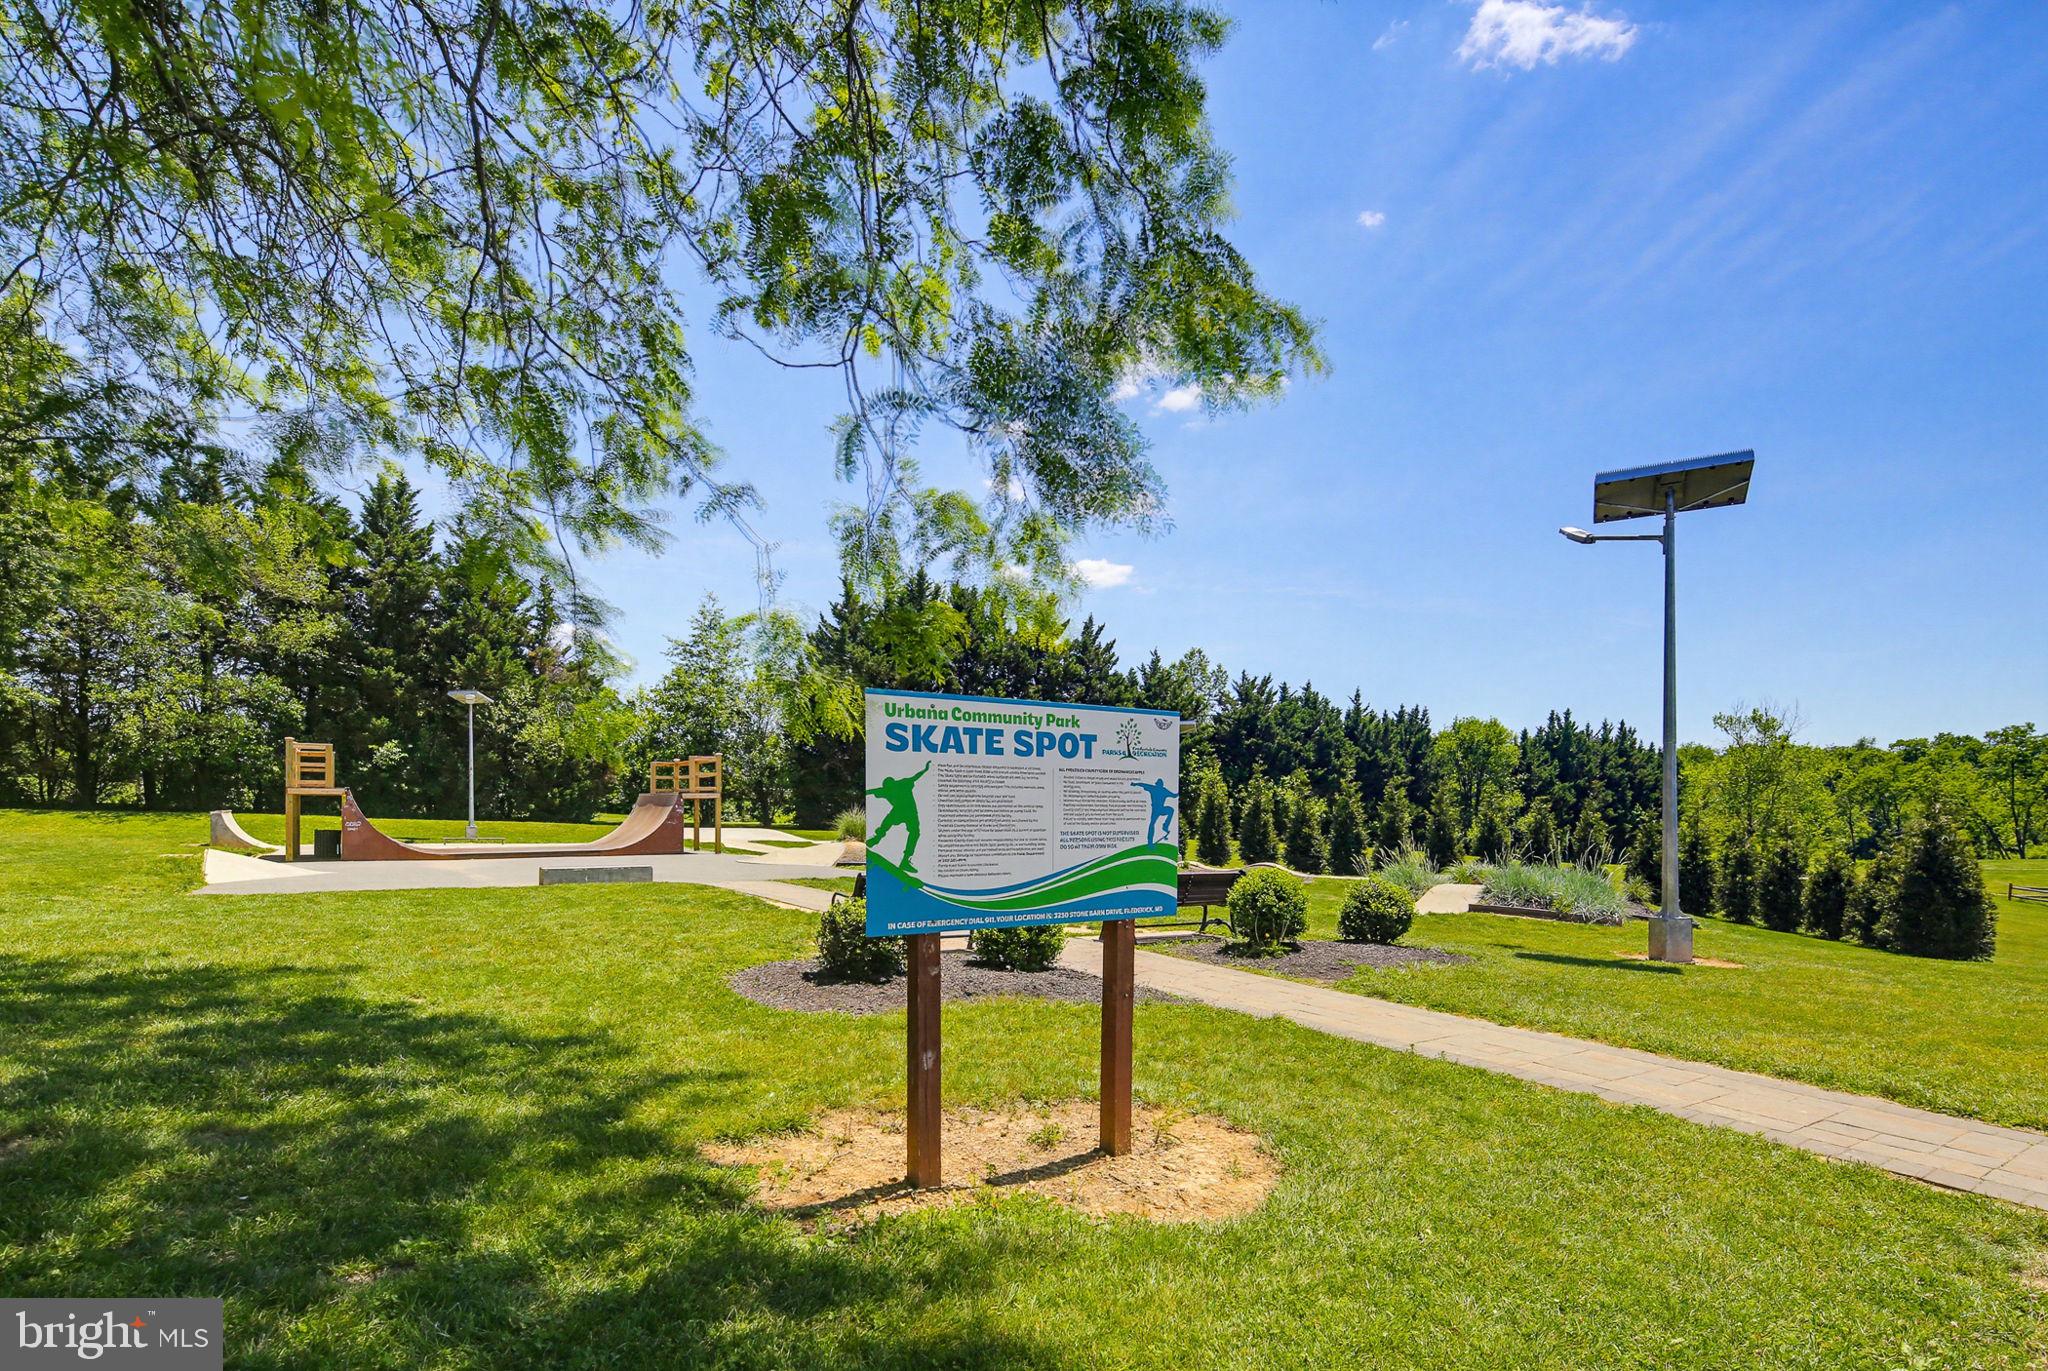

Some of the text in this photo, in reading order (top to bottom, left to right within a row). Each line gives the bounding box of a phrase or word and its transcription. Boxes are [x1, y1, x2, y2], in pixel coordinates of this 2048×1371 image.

[884, 702, 1080, 730] Urbana Community Park
[885, 722, 1098, 760] SKATE SPOT
[897, 921, 916, 930] CASE
[927, 919, 968, 928] EMERGENCY
[996, 915, 1014, 923] YOUR
[1014, 913, 1046, 922] LOCATION
